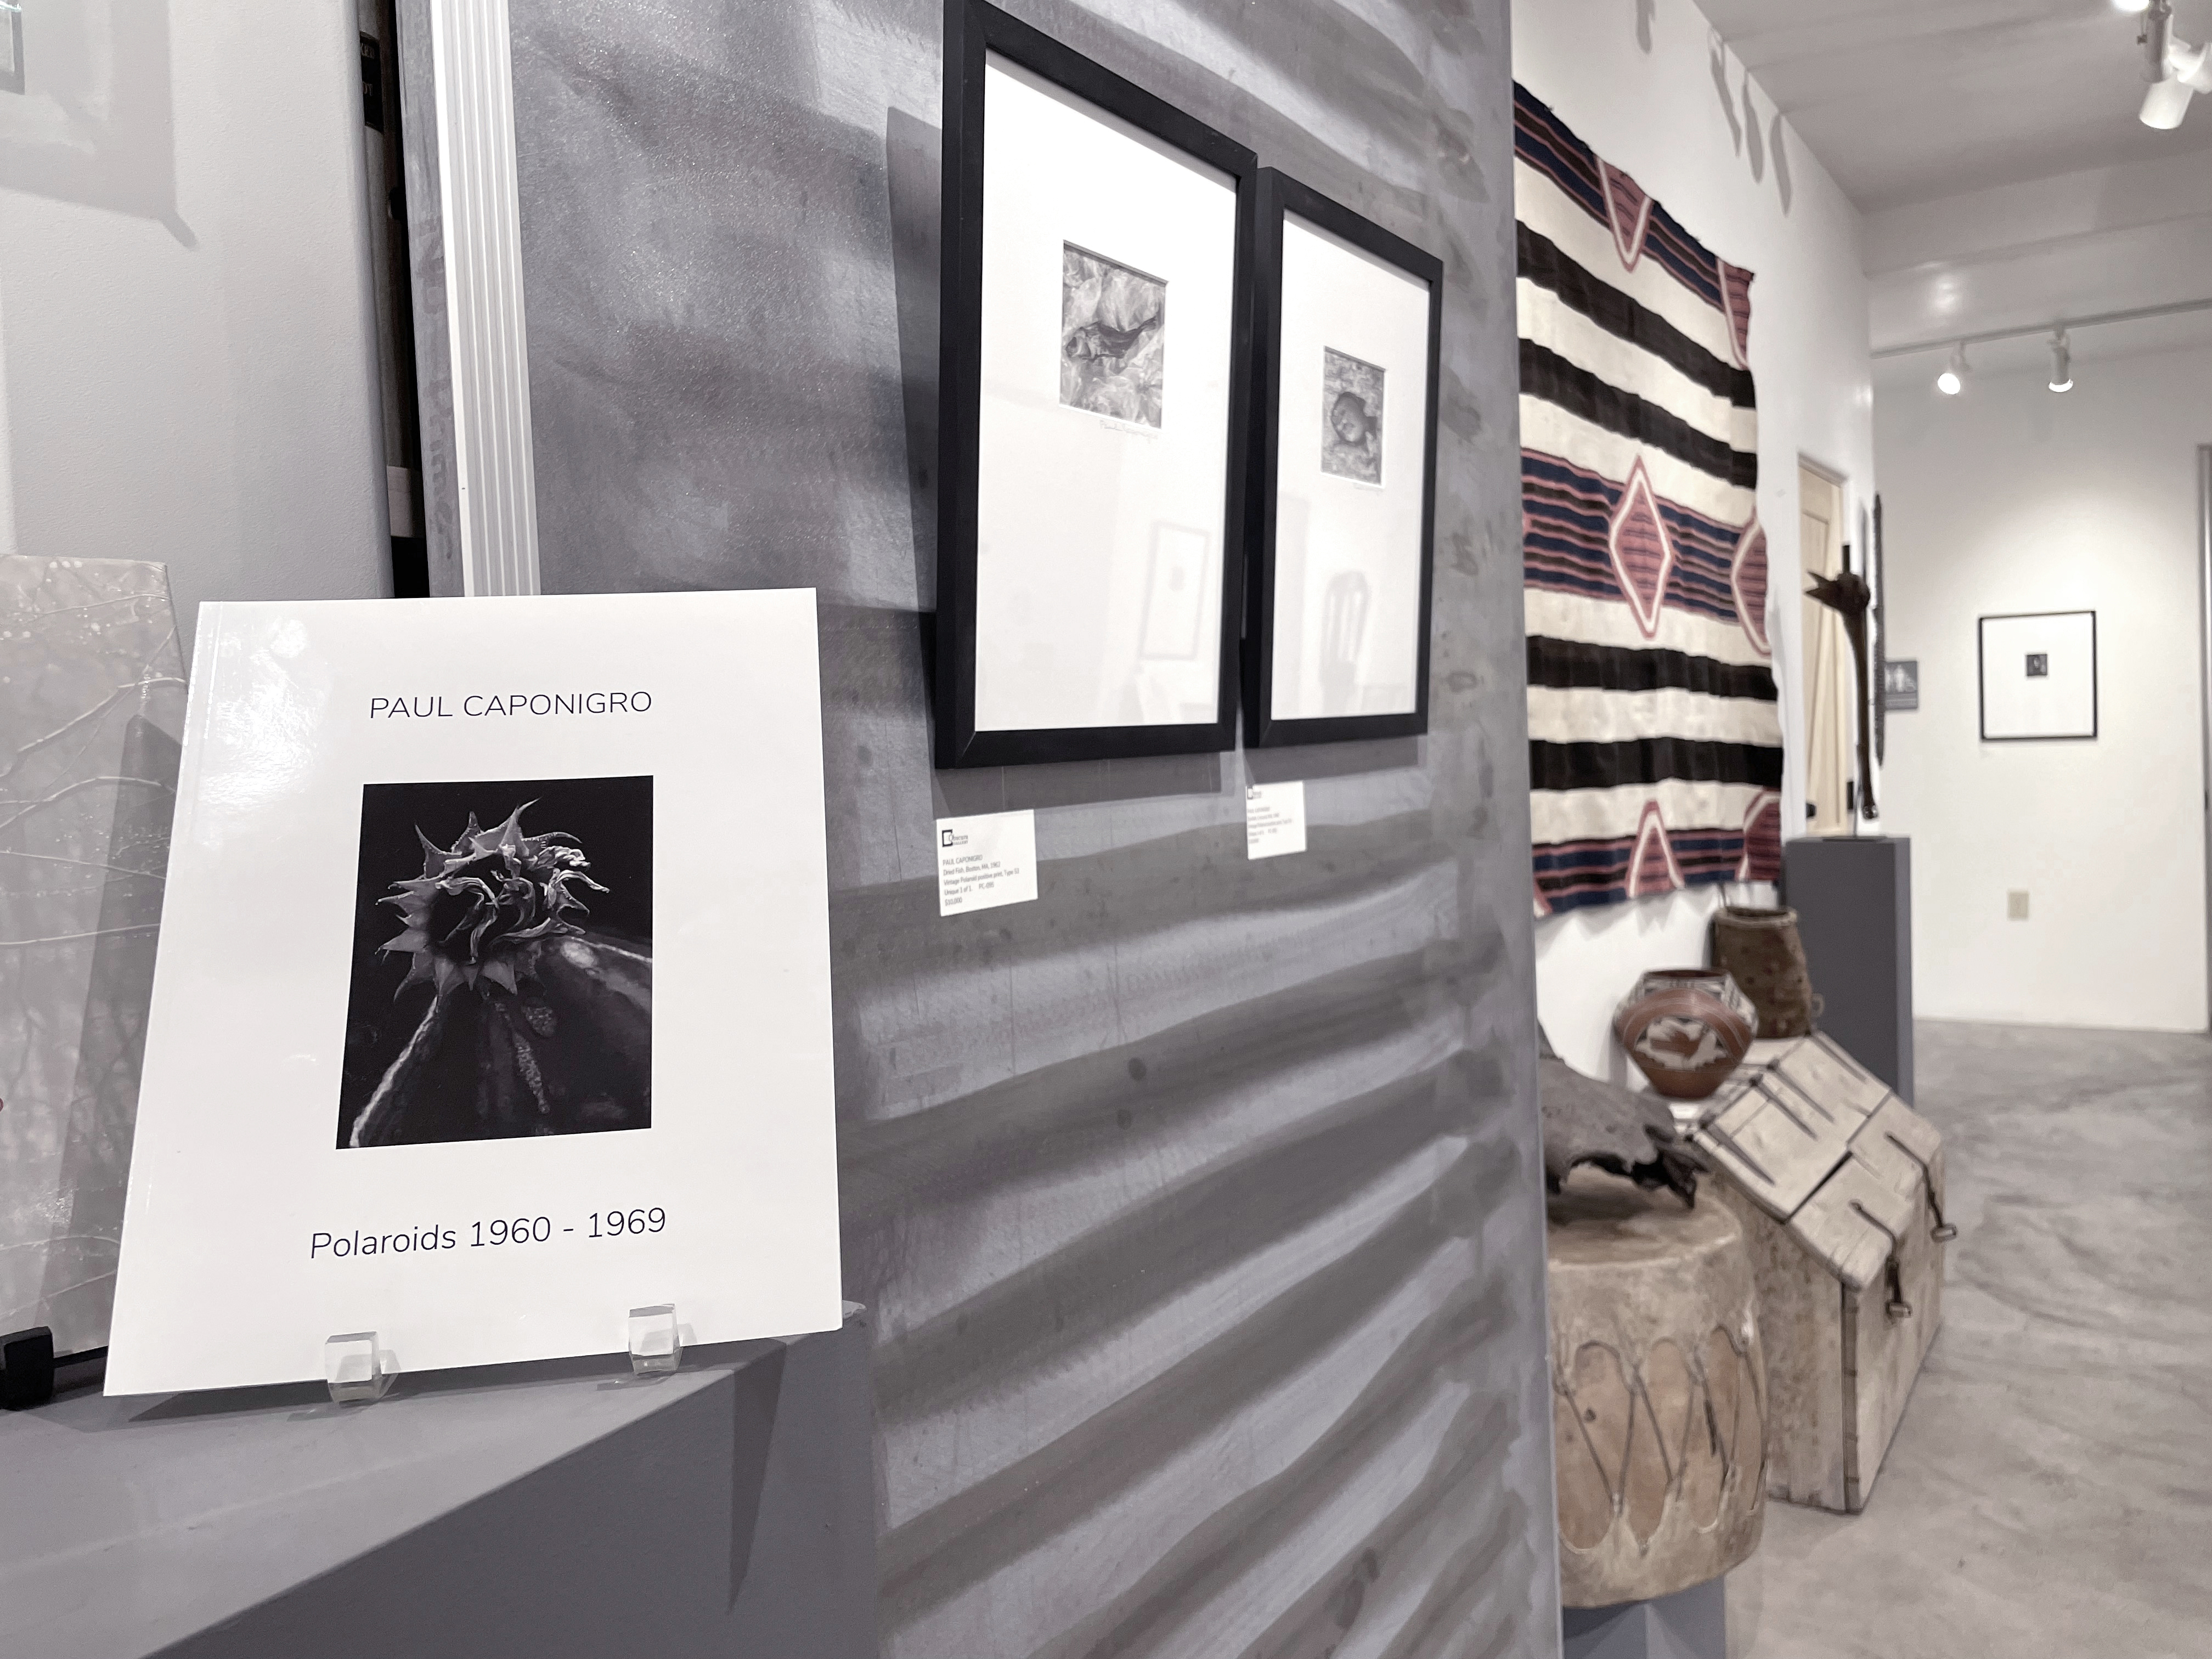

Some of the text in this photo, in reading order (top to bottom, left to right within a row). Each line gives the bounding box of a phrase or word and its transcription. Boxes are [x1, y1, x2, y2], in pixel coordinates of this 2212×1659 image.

[370, 691, 651, 719] PAUL CAPONIGRO
[956, 855, 983, 864] CAPONIGRO
[311, 1224, 456, 1259] Polaroids
[471, 1216, 551, 1247] 1960
[589, 1207, 665, 1238] 1969
